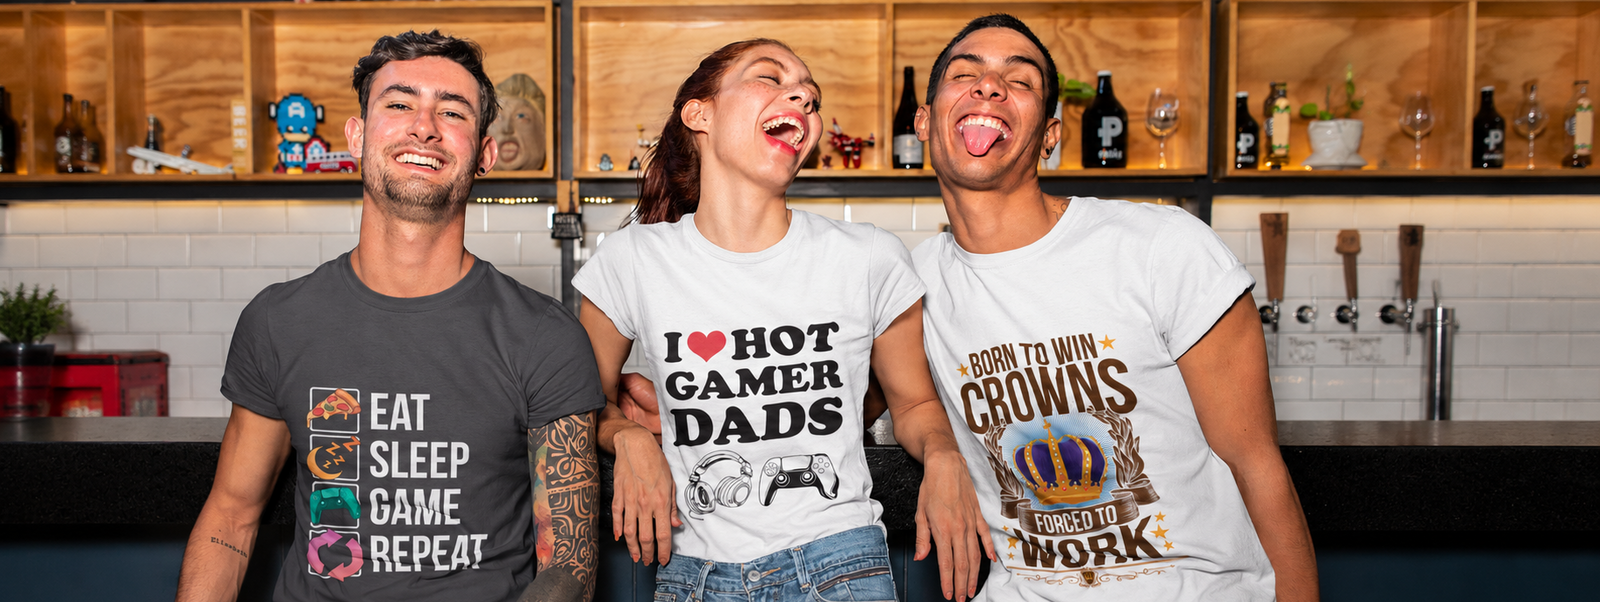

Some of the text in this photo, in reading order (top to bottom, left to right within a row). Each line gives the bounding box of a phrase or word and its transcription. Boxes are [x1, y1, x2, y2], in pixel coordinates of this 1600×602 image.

[233, 105, 247, 149] BEER
[664, 321, 840, 363] I HOT
[968, 333, 1099, 379] BORN TO WIN
[665, 359, 844, 401] GAMER
[960, 358, 1138, 435] CROWNS
[370, 392, 431, 431] EAT
[670, 396, 843, 447] DADS
[369, 440, 470, 479] SLEEP
[369, 487, 461, 526] GAME
[1034, 504, 1118, 534] FORCED TO
[370, 533, 489, 573] REPEAT
[1013, 514, 1164, 569] WORK
